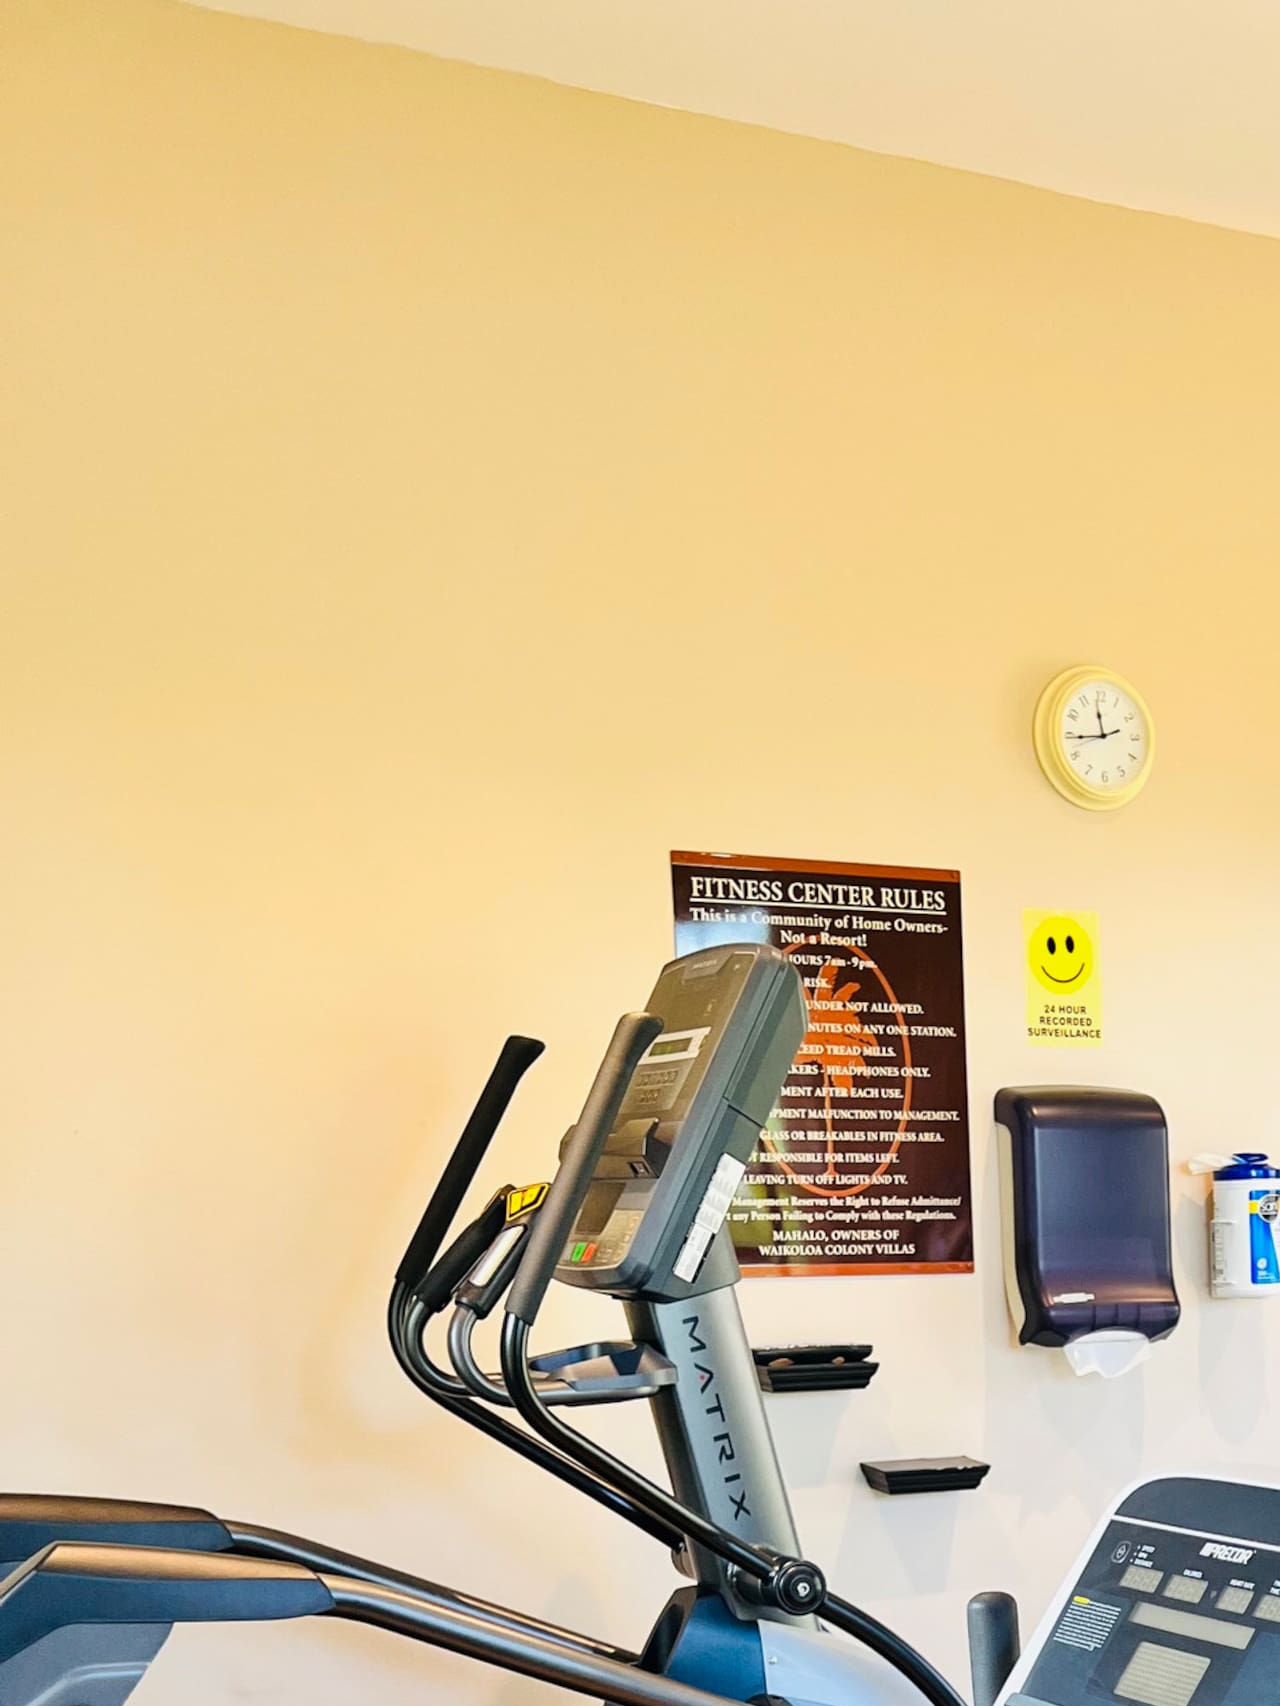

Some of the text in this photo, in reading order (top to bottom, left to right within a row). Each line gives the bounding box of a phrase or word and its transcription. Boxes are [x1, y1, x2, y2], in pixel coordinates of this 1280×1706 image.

[1124, 713, 1135, 723] 2
[1084, 764, 1093, 775] 7
[1116, 766, 1126, 778] 5
[1101, 771, 1109, 783] 6
[690, 876, 945, 911] FITNESS CENTER RULES
[689, 907, 949, 933] This is a Community of Home Owners-
[780, 930, 867, 948] Not a Resort!
[806, 1001, 924, 1015] UNDER NOT ALLOWED.
[1044, 1004, 1087, 1014] 24 HOUR
[1039, 1016, 1092, 1027] RECORDED
[844, 1024, 861, 1035] ON
[863, 1025, 884, 1035] ANY
[886, 1026, 909, 1036] ONE
[911, 1026, 957, 1038] STATION.
[1027, 1027, 1102, 1039] SURVEILLANCE
[825, 1045, 861, 1056] TREAD
[863, 1046, 897, 1057] MILLS.
[827, 1065, 899, 1077] HEADPHONES
[901, 1067, 932, 1078] ONLY.
[780, 1086, 904, 1099] MENT AFTER EACH USE.
[808, 1109, 877, 1120] MALFUNCTION
[879, 1110, 892, 1120] TO
[893, 1110, 960, 1121] MANAGEMENT.
[759, 1129, 945, 1142] GLASS OR BREAKABLES IN FITNESS AREA.
[760, 1152, 823, 1163] RESPONSIBLE
[825, 1152, 844, 1163] FOR
[845, 1153, 875, 1163] ITEMS
[875, 1153, 900, 1163] LEFT.
[744, 1174, 908, 1186] LEAVING TURN OFF LIGHTS AND TV.
[791, 1197, 828, 1207] Reserves
[829, 1196, 844, 1207] the
[845, 1196, 869, 1208] Right
[871, 1198, 880, 1207] to
[881, 1196, 909, 1207] Refuse
[732, 1213, 750, 1223] any
[750, 1211, 781, 1221] Person
[782, 1210, 814, 1223] Failing
[814, 1211, 824, 1221] to
[825, 1211, 861, 1223] Comply
[861, 1210, 880, 1221] with
[880, 1210, 903, 1221] these
[773, 1229, 900, 1243] MAHALO, OWNERS OF
[759, 1244, 916, 1256] WAIKOLOA COLONY VILLAS
[682, 1316, 752, 1521] MATRIX
[1206, 1542, 1254, 1565] PRECOR
